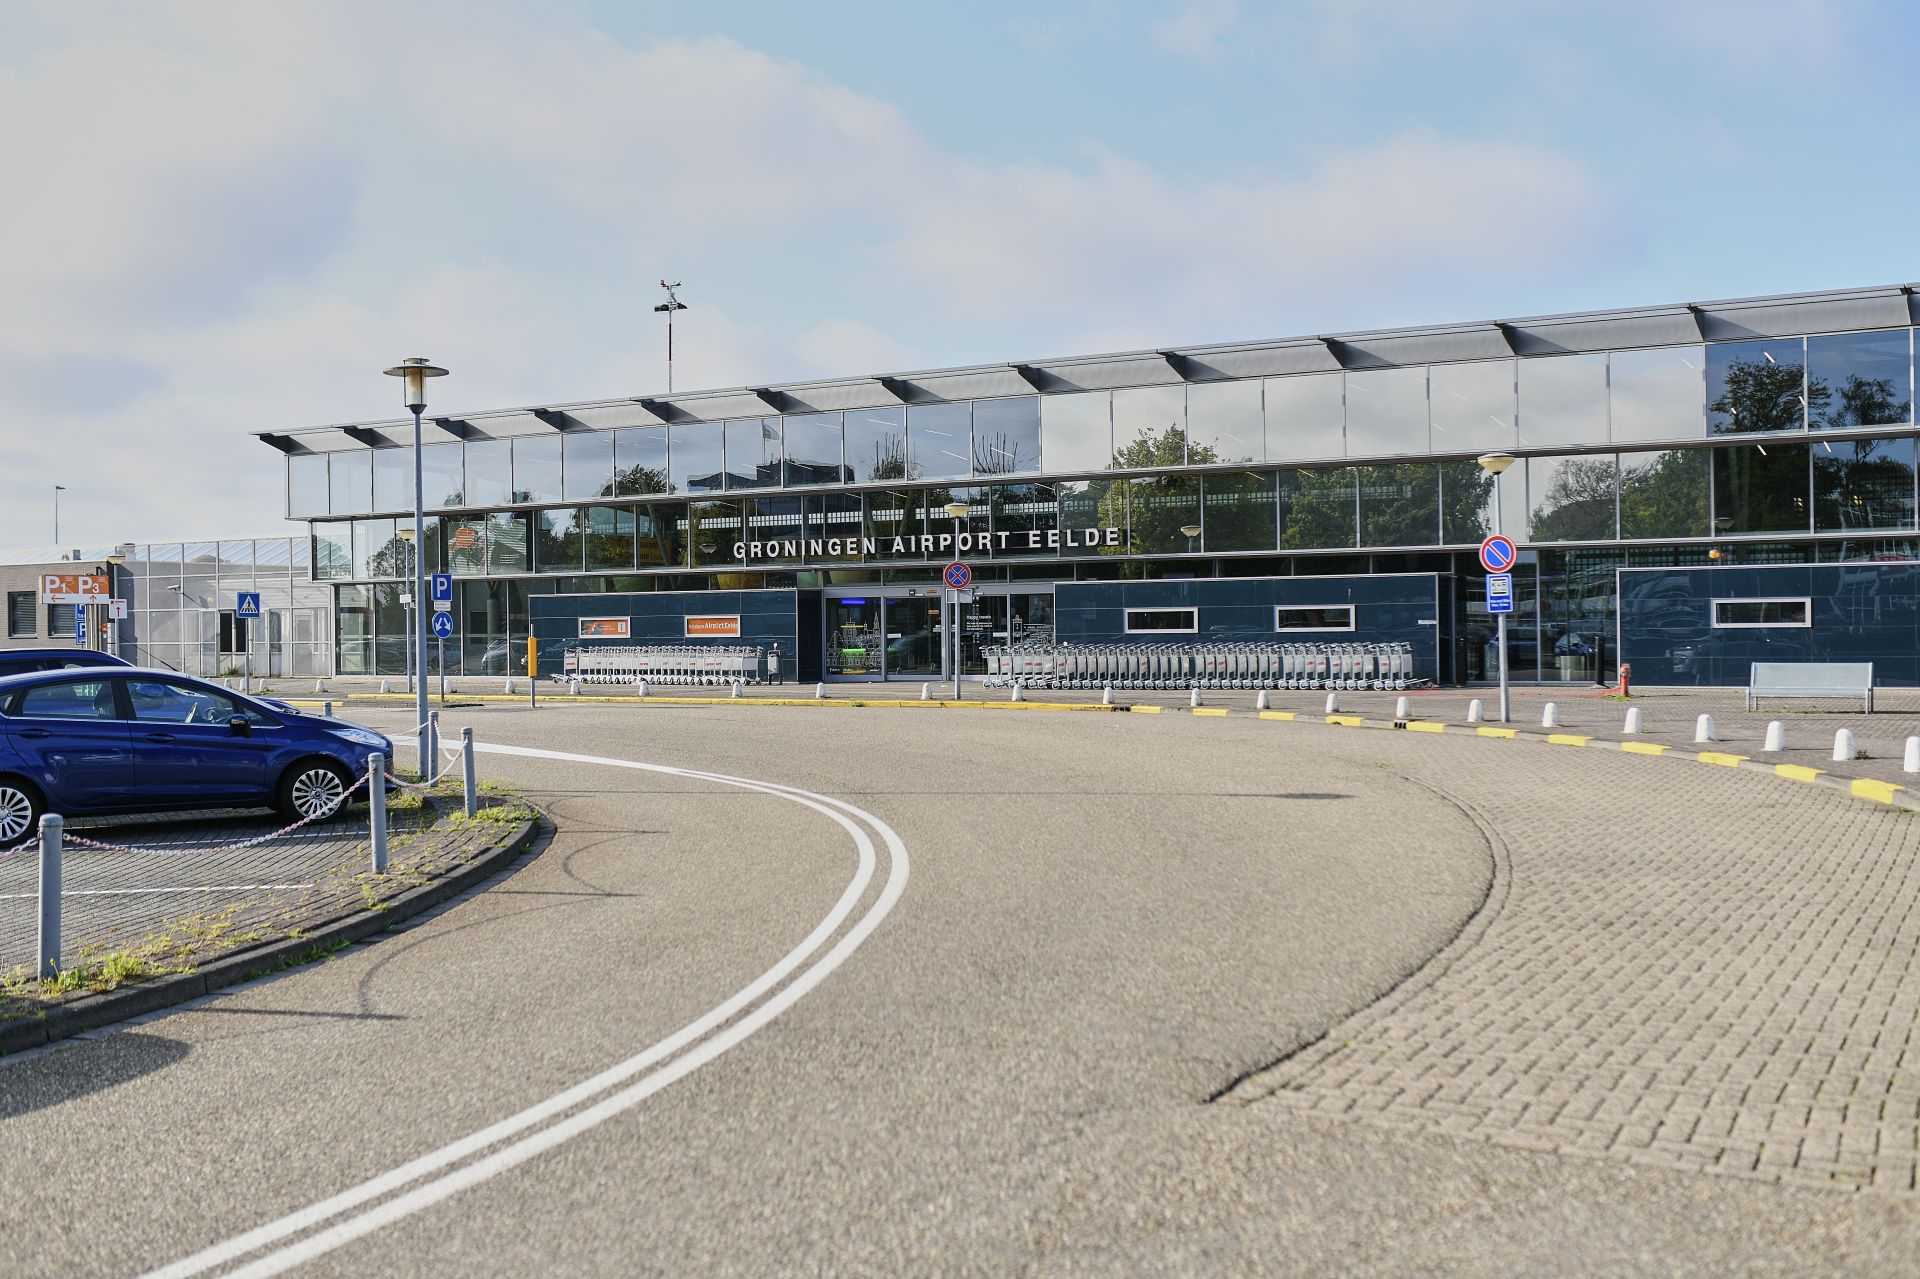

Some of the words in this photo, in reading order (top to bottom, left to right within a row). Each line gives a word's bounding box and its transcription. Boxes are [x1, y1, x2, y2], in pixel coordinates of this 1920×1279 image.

[733, 537, 876, 559] GRONINGEN
[892, 531, 1010, 553] AIRPORT
[1028, 527, 1120, 548] EELDE
[436, 577, 448, 598] P
